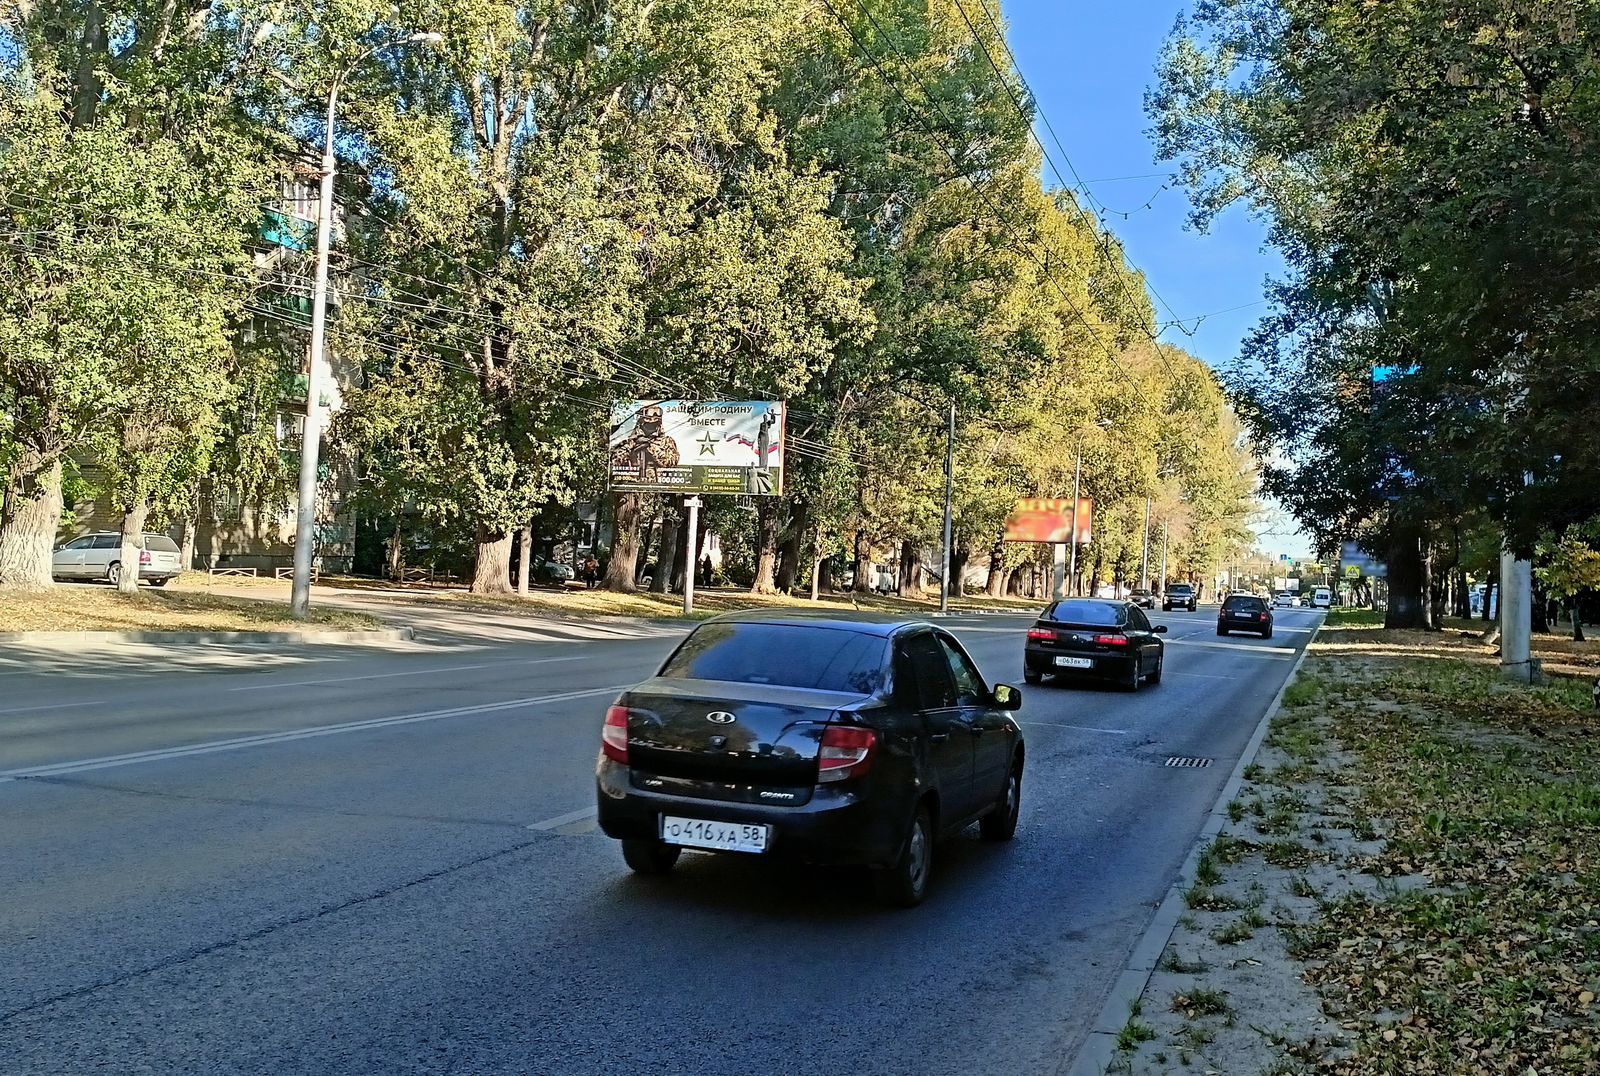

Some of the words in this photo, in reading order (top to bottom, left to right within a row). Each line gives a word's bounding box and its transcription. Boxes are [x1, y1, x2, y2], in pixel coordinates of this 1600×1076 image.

[714, 406, 753, 414] РОДИНУ
[690, 418, 726, 426] ВМЕСТЕ
[670, 821, 737, 843] О416ХА
[743, 826, 759, 840] 58
